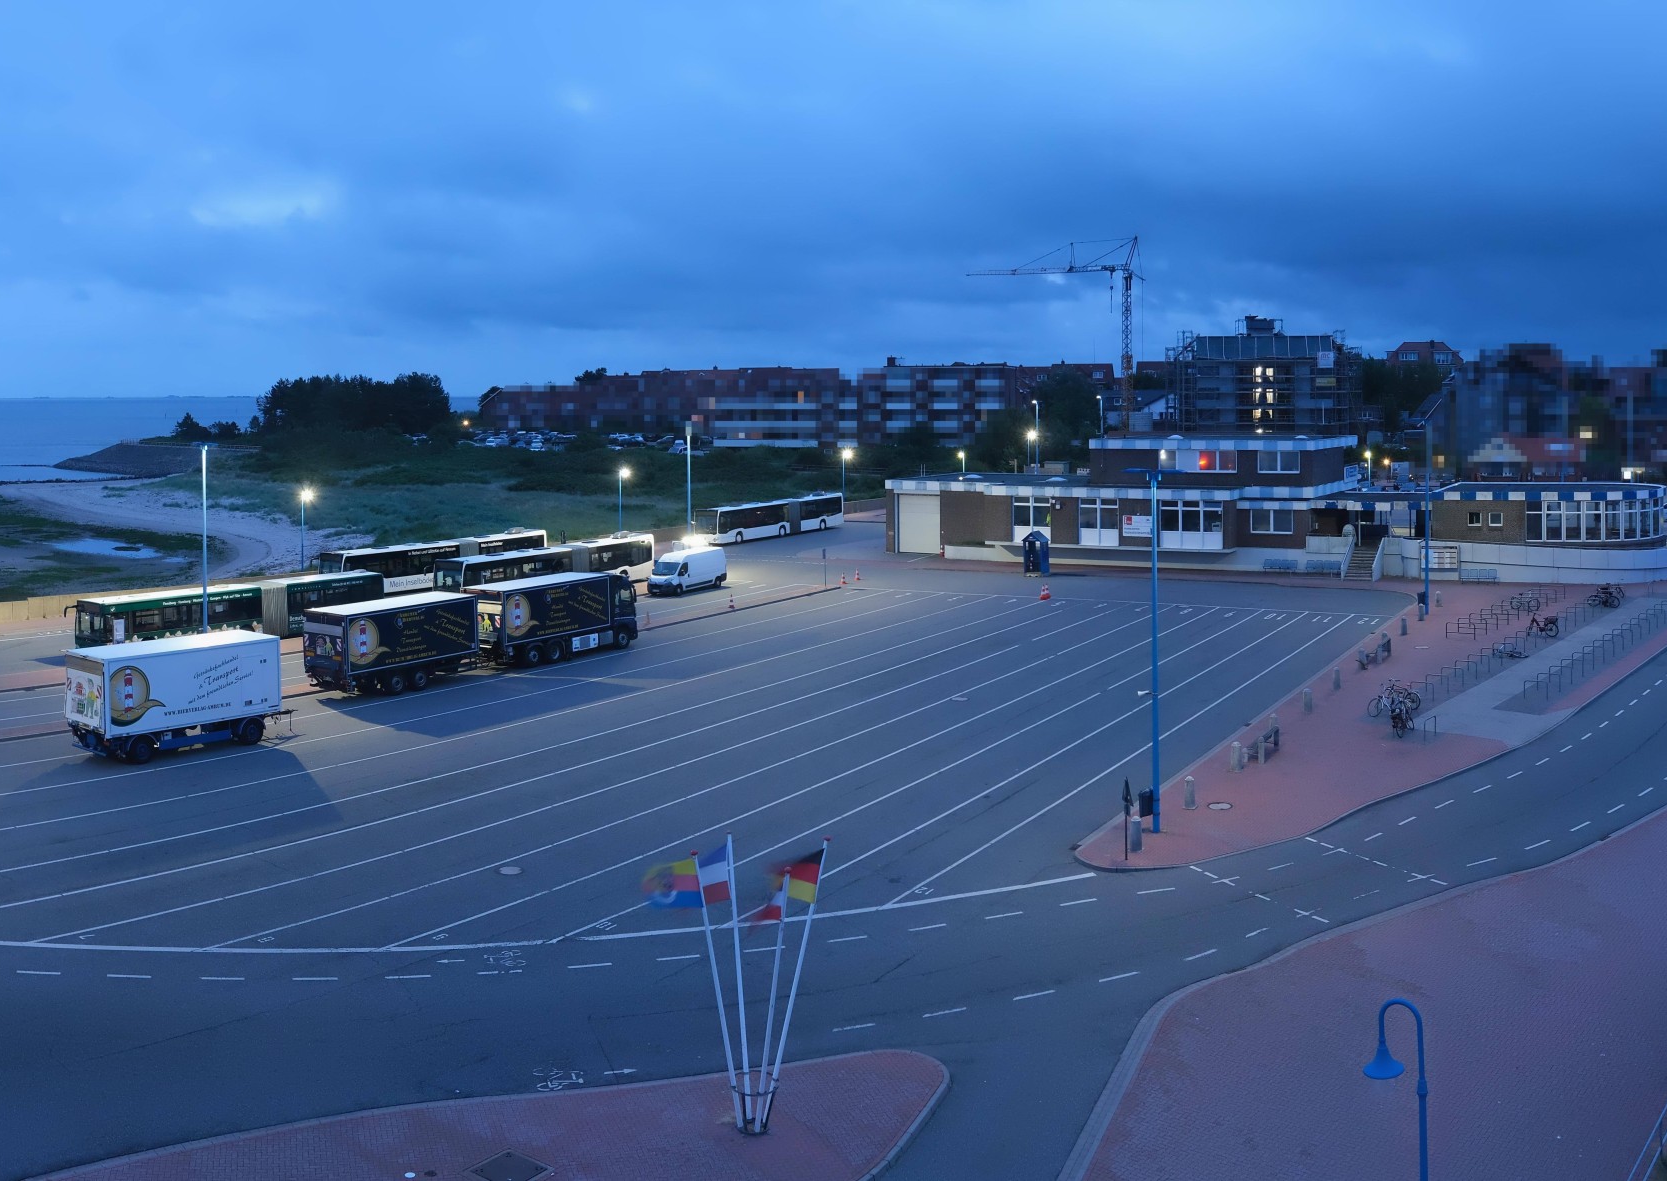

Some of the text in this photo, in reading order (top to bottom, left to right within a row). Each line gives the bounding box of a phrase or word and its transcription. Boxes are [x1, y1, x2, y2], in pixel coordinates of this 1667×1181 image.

[389, 578, 405, 588] Mein
[1311, 615, 1332, 623] 11
[1357, 617, 1380, 625] 12
[203, 665, 239, 686] Transport
[913, 886, 935, 895] 12
